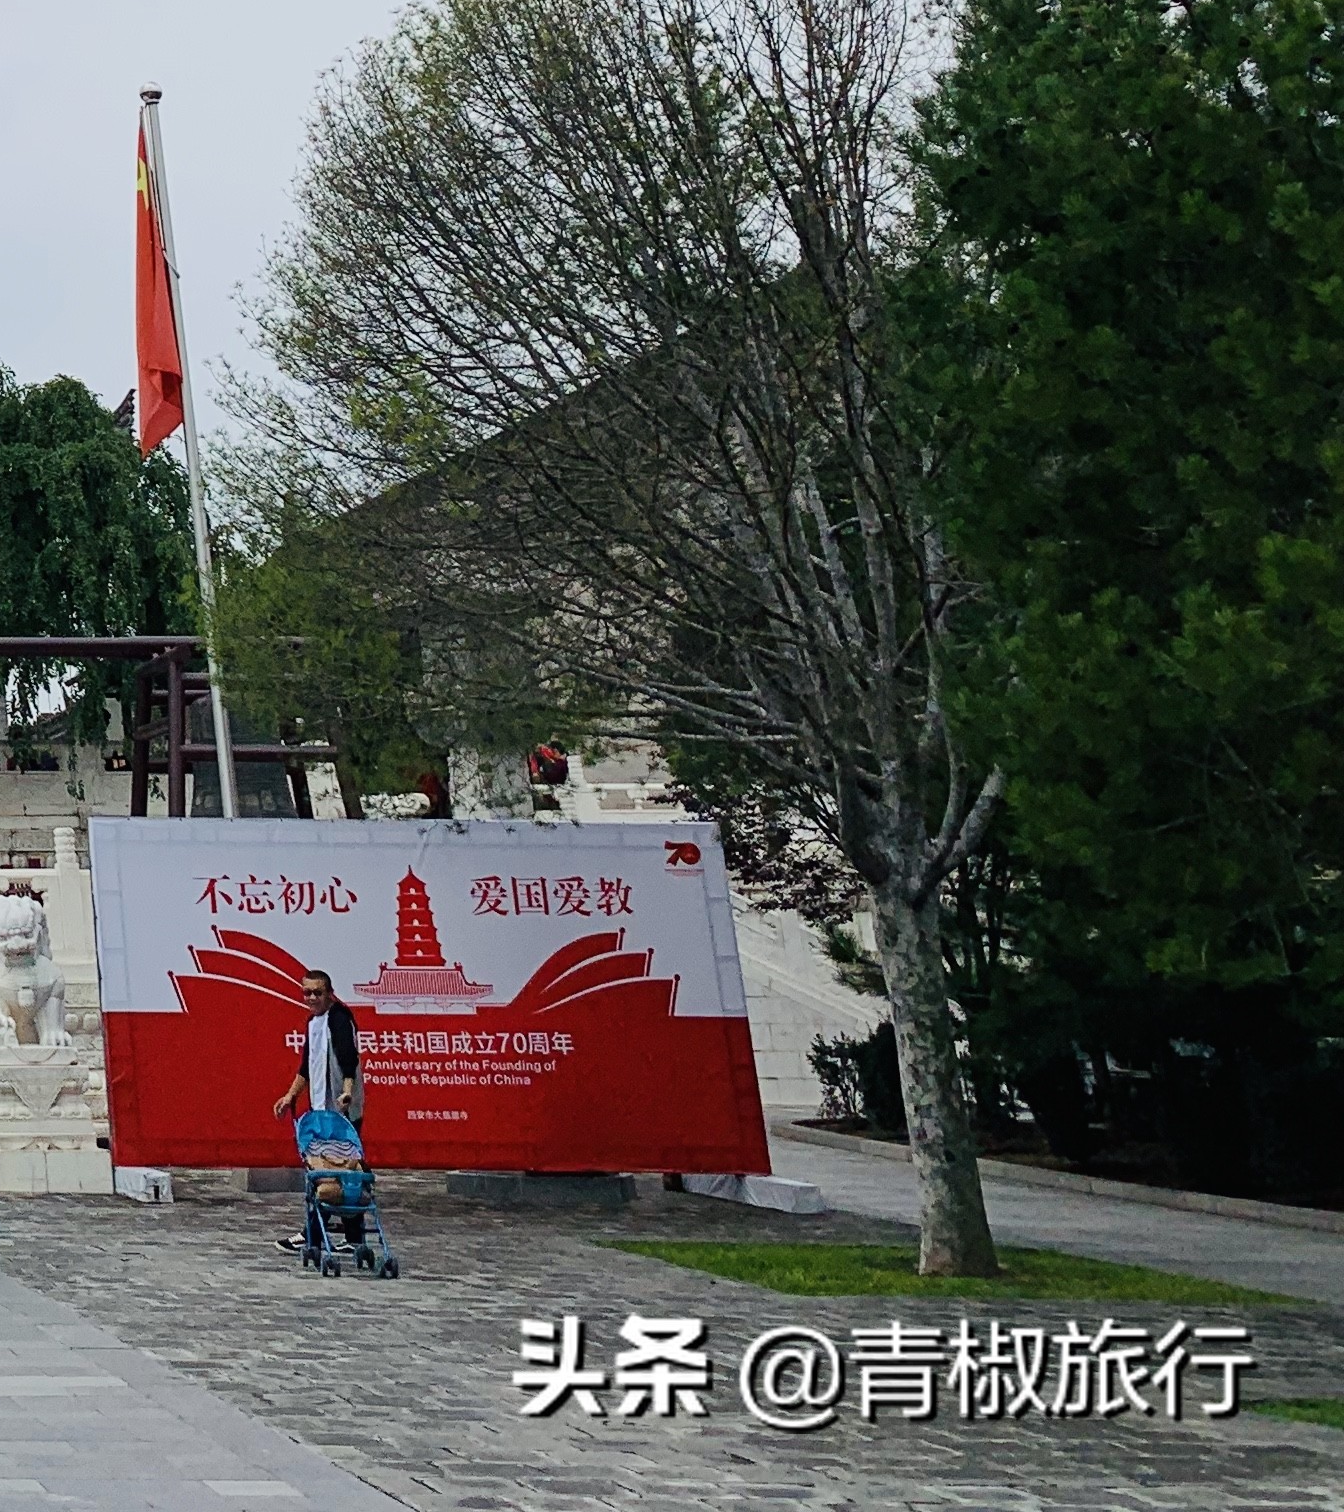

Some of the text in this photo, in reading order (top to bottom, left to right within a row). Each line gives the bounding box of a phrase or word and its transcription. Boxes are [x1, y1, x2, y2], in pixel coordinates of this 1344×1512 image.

[192, 874, 358, 915] 不忘初心
[470, 876, 634, 916] 爱国爱教
[285, 1030, 574, 1055] 中民共和国成立70周年
[364, 1059, 557, 1073] Anniversary of the Founding of
[363, 1073, 531, 1086] People's Republic of China
